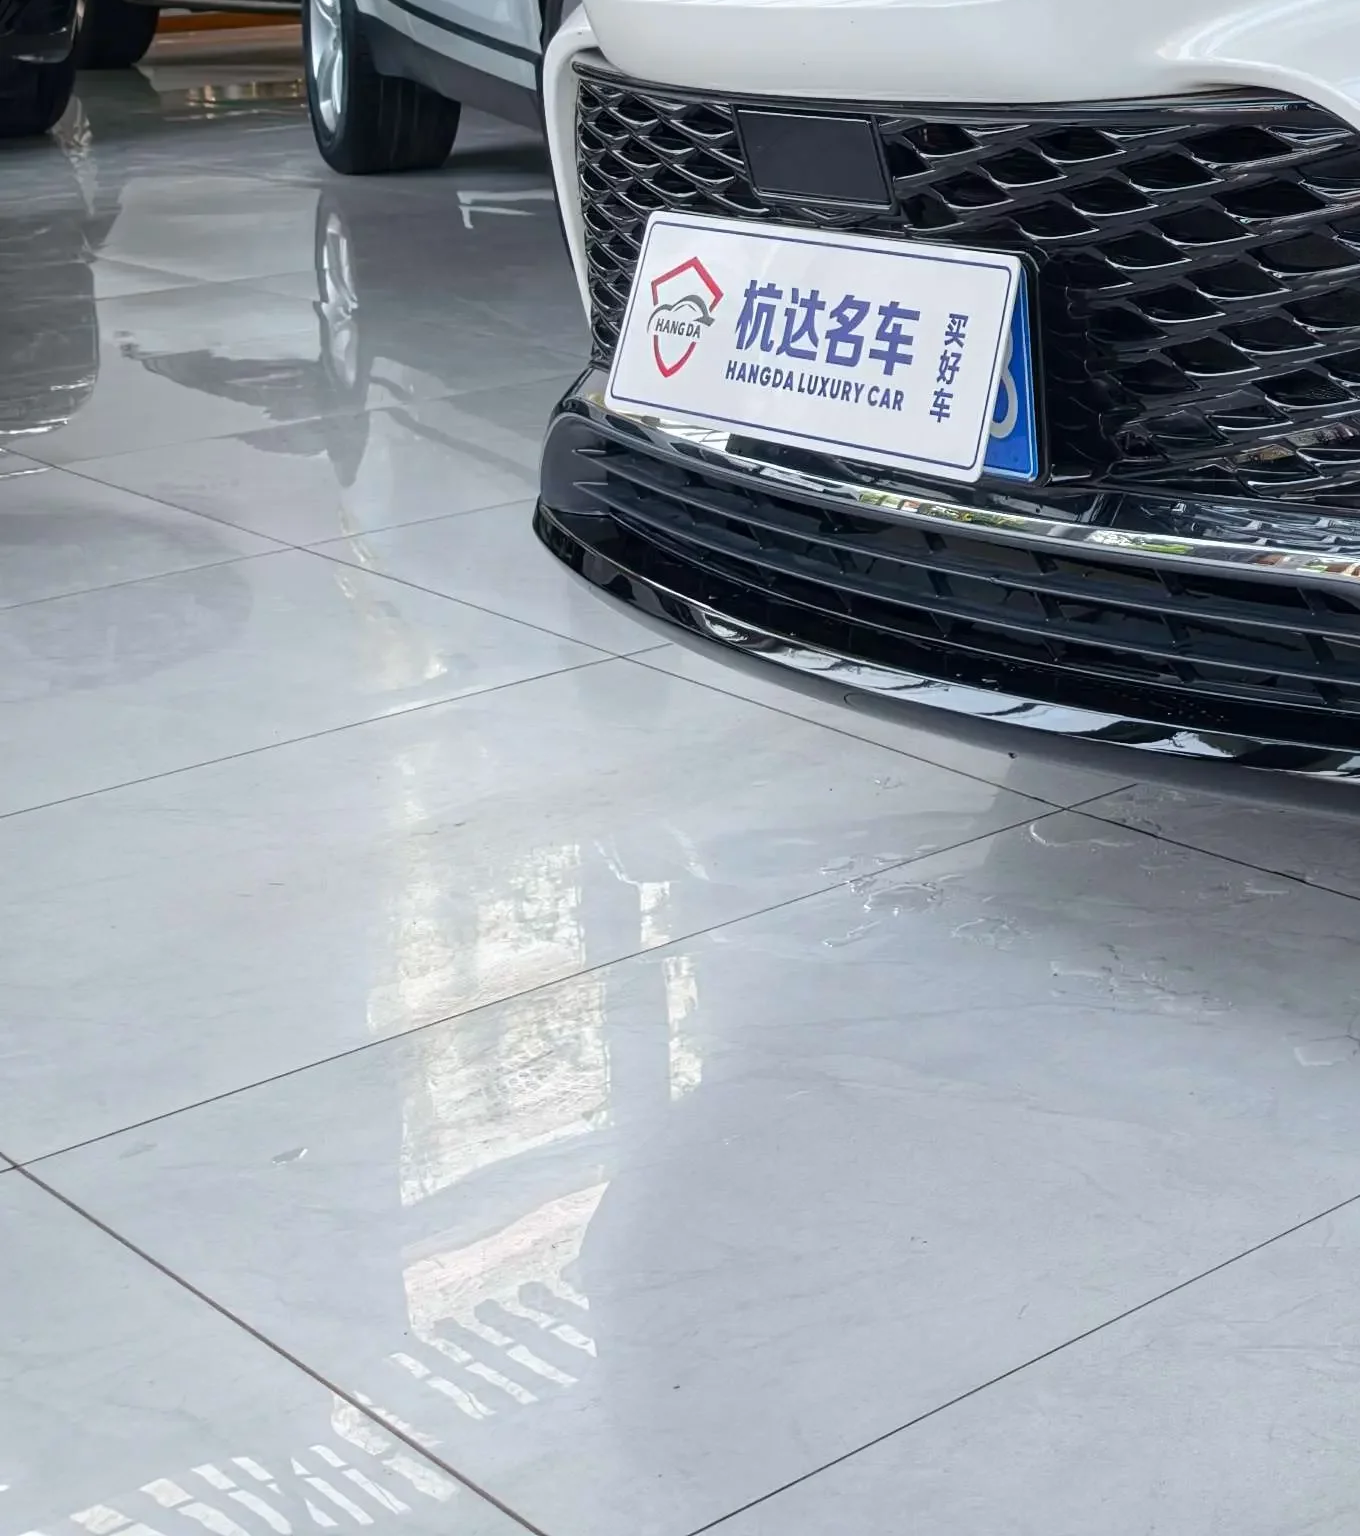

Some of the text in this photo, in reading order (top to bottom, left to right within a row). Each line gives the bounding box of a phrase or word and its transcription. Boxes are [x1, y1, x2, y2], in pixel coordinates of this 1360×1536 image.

[655, 318, 702, 339] HANG DA
[735, 279, 921, 376] 杭达名车
[725, 359, 905, 412] HANGDA LUXURY CAR
[928, 312, 970, 424] 买好车
